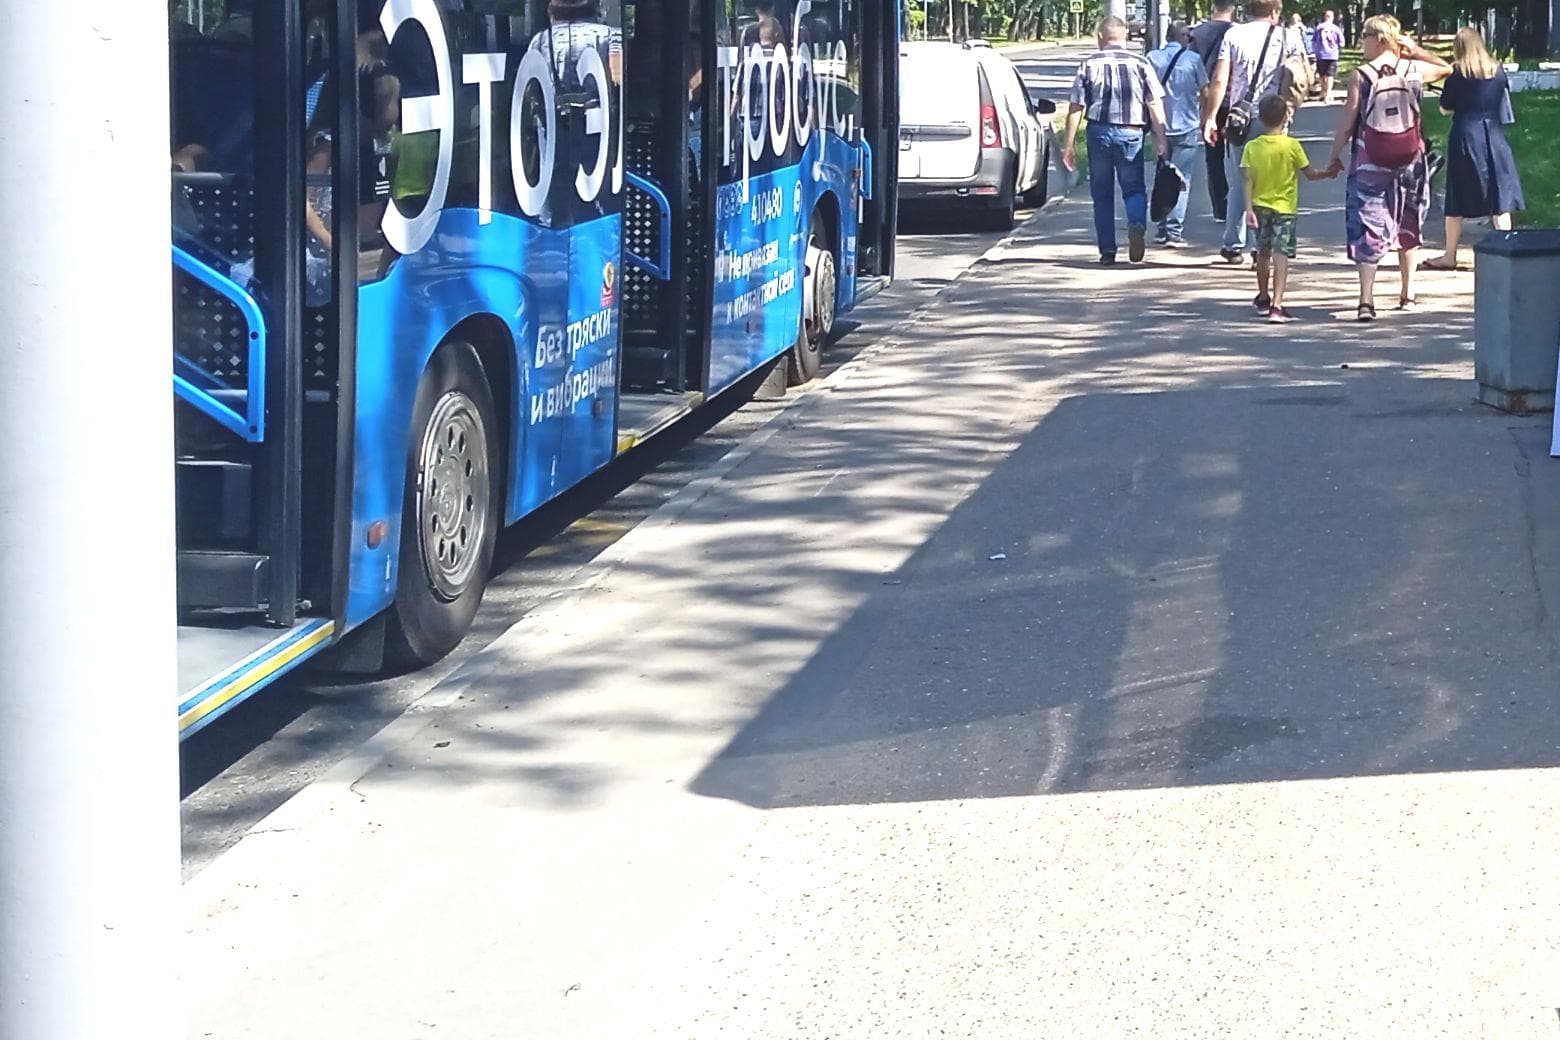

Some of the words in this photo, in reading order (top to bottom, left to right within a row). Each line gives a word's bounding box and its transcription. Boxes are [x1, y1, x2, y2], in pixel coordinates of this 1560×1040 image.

[728, 248, 742, 282] Не
[535, 324, 562, 369] Без
[566, 308, 612, 361] тряски
